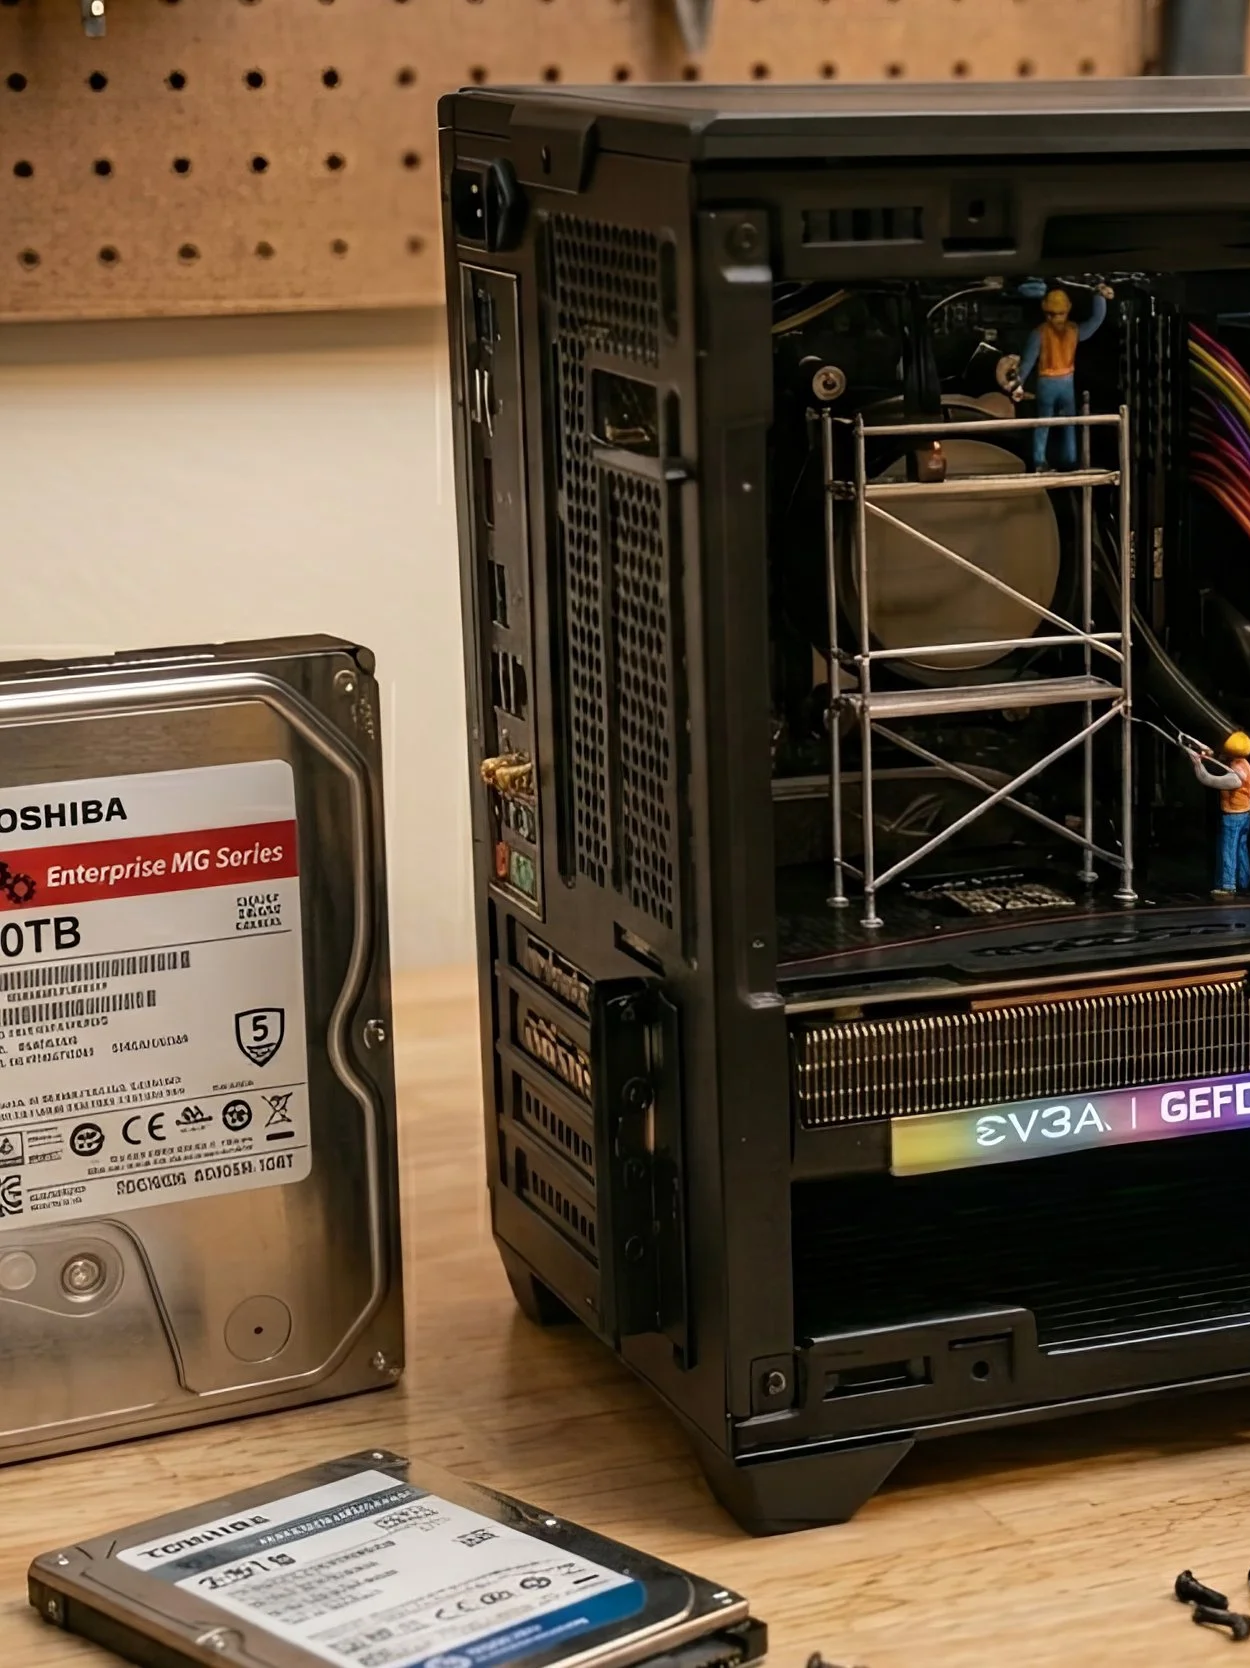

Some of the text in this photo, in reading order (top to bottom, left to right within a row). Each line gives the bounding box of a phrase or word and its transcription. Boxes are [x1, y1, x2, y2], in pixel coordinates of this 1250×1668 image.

[0, 798, 127, 833] OSHIBA
[47, 856, 166, 887] Enterprise
[171, 849, 210, 873] MG
[253, 1015, 268, 1042] 5
[122, 1112, 166, 1145] CE
